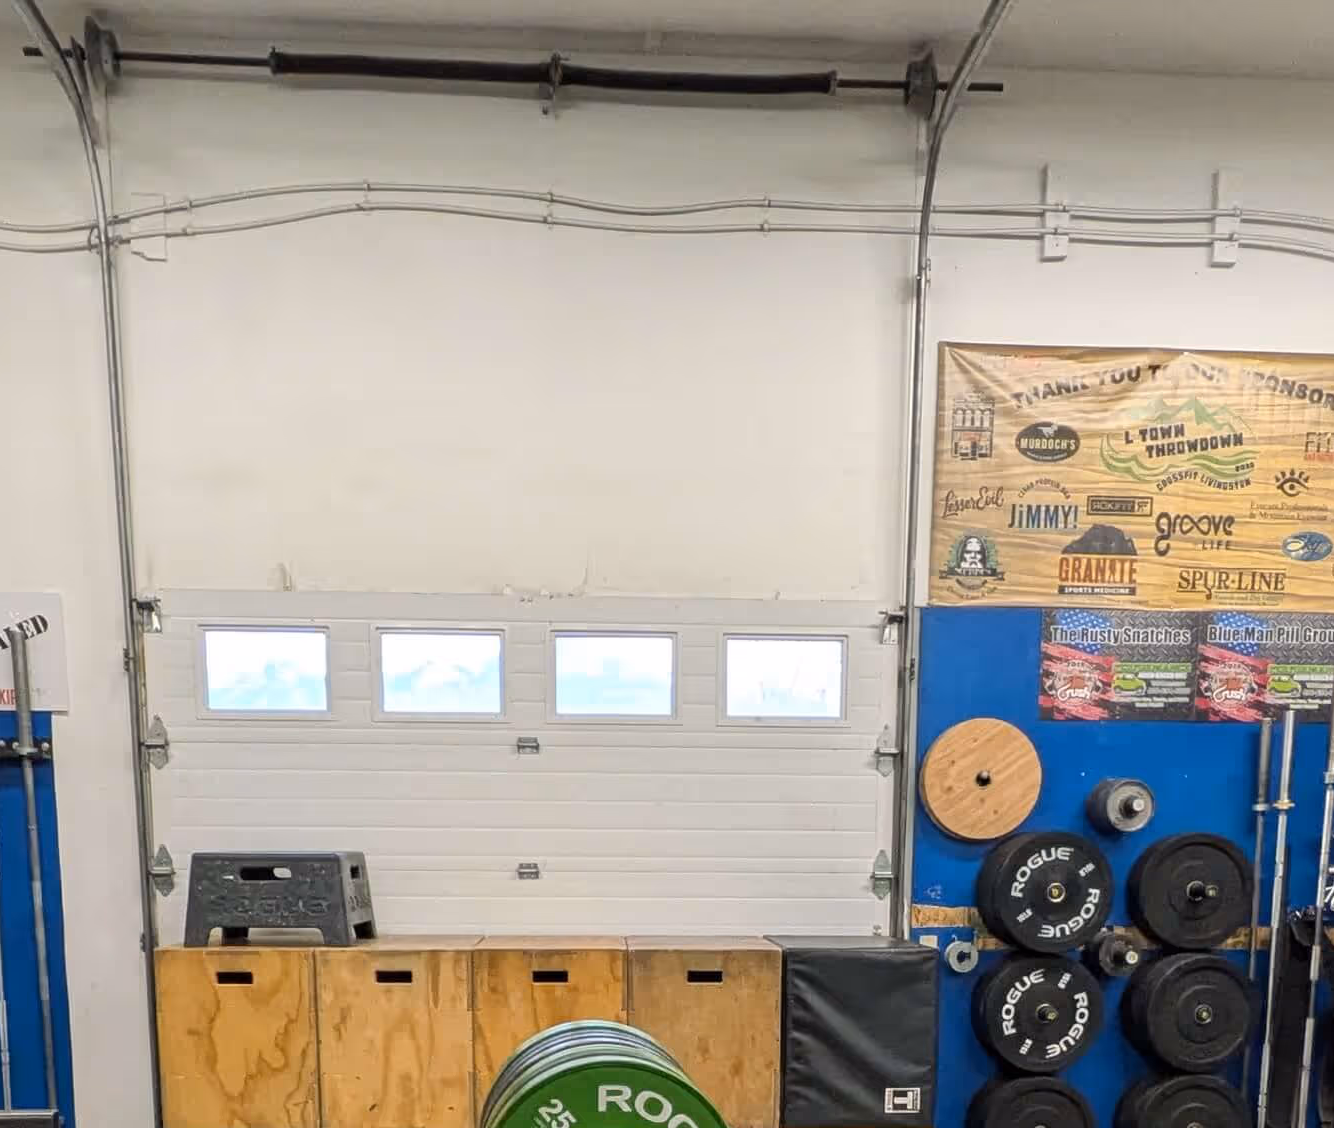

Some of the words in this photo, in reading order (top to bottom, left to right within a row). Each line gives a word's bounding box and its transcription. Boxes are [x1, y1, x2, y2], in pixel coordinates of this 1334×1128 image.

[1020, 438, 1076, 450] MURDOCH'S
[1124, 430, 1134, 444] L
[1139, 424, 1185, 442] TOWN
[1146, 432, 1244, 458] THROWDOWN
[1156, 470, 1198, 491] CROSSFIT
[1200, 474, 1252, 491] LIVINGSTON
[1154, 511, 1235, 556] groove
[1202, 540, 1232, 550] LIFE
[1058, 556, 1138, 584] GRANITE
[1051, 626, 1079, 643] The
[1080, 626, 1120, 646] Rusty
[1123, 627, 1192, 644] Snatches
[1208, 626, 1239, 644] Blue
[1241, 627, 1274, 644] Man
[1275, 627, 1301, 644] Pill
[1011, 847, 1075, 898] ROGUE
[1037, 888, 1100, 938] ROGUE
[1002, 968, 1046, 1036] ROGUE
[1045, 991, 1090, 1059] ROGUE
